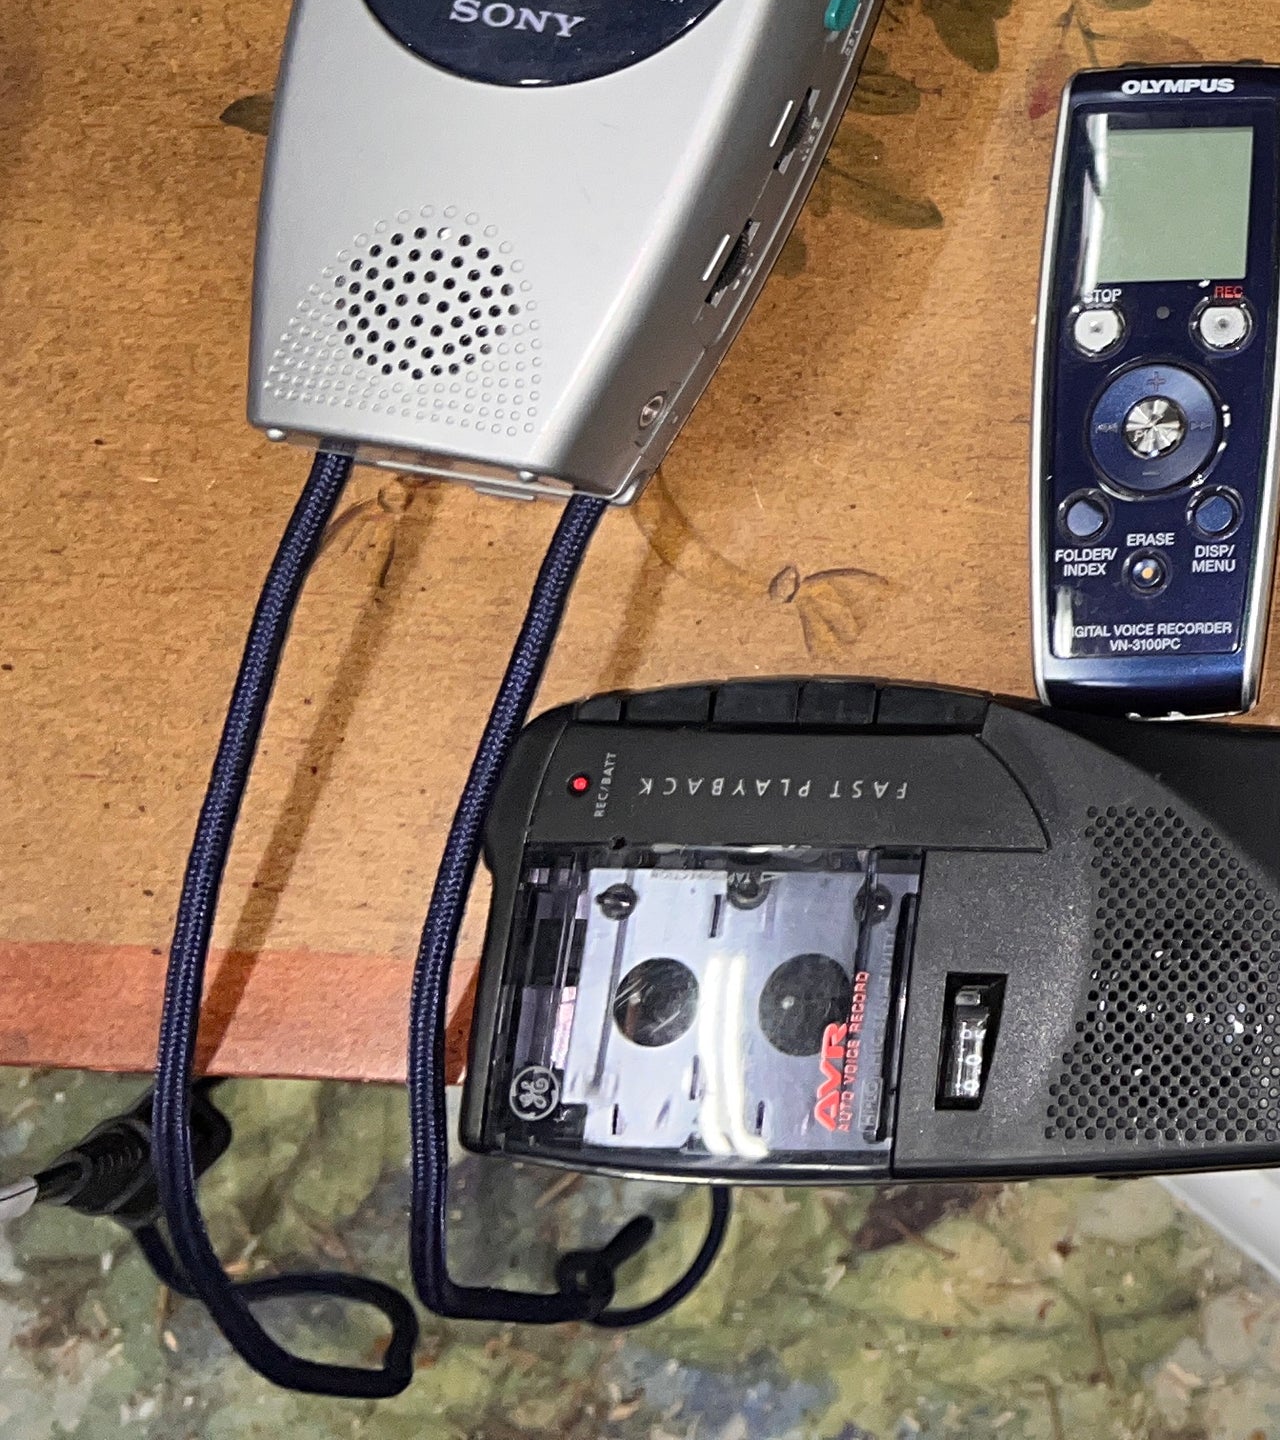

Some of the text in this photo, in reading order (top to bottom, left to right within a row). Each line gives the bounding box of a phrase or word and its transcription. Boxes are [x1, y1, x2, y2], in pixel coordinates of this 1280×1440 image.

[1122, 78, 1234, 95] OLYMPUS
[1083, 288, 1122, 303] STOP
[1214, 285, 1243, 299] REC
[1126, 533, 1175, 547] ERASE
[1055, 547, 1117, 561] FOLDER/
[1194, 545, 1235, 558] DISP/
[1063, 563, 1106, 576] INDEX
[1192, 560, 1235, 573] MENU
[1066, 622, 1232, 638] IGITAL VOICE RECORDER
[1110, 637, 1182, 651] VN-3100PC
[594, 752, 617, 817] REC/BATT
[639, 777, 908, 799] FAST PLAYBACK
[838, 971, 870, 1133] AUTO VOICE RECORD
[813, 1021, 848, 1132] AVR
